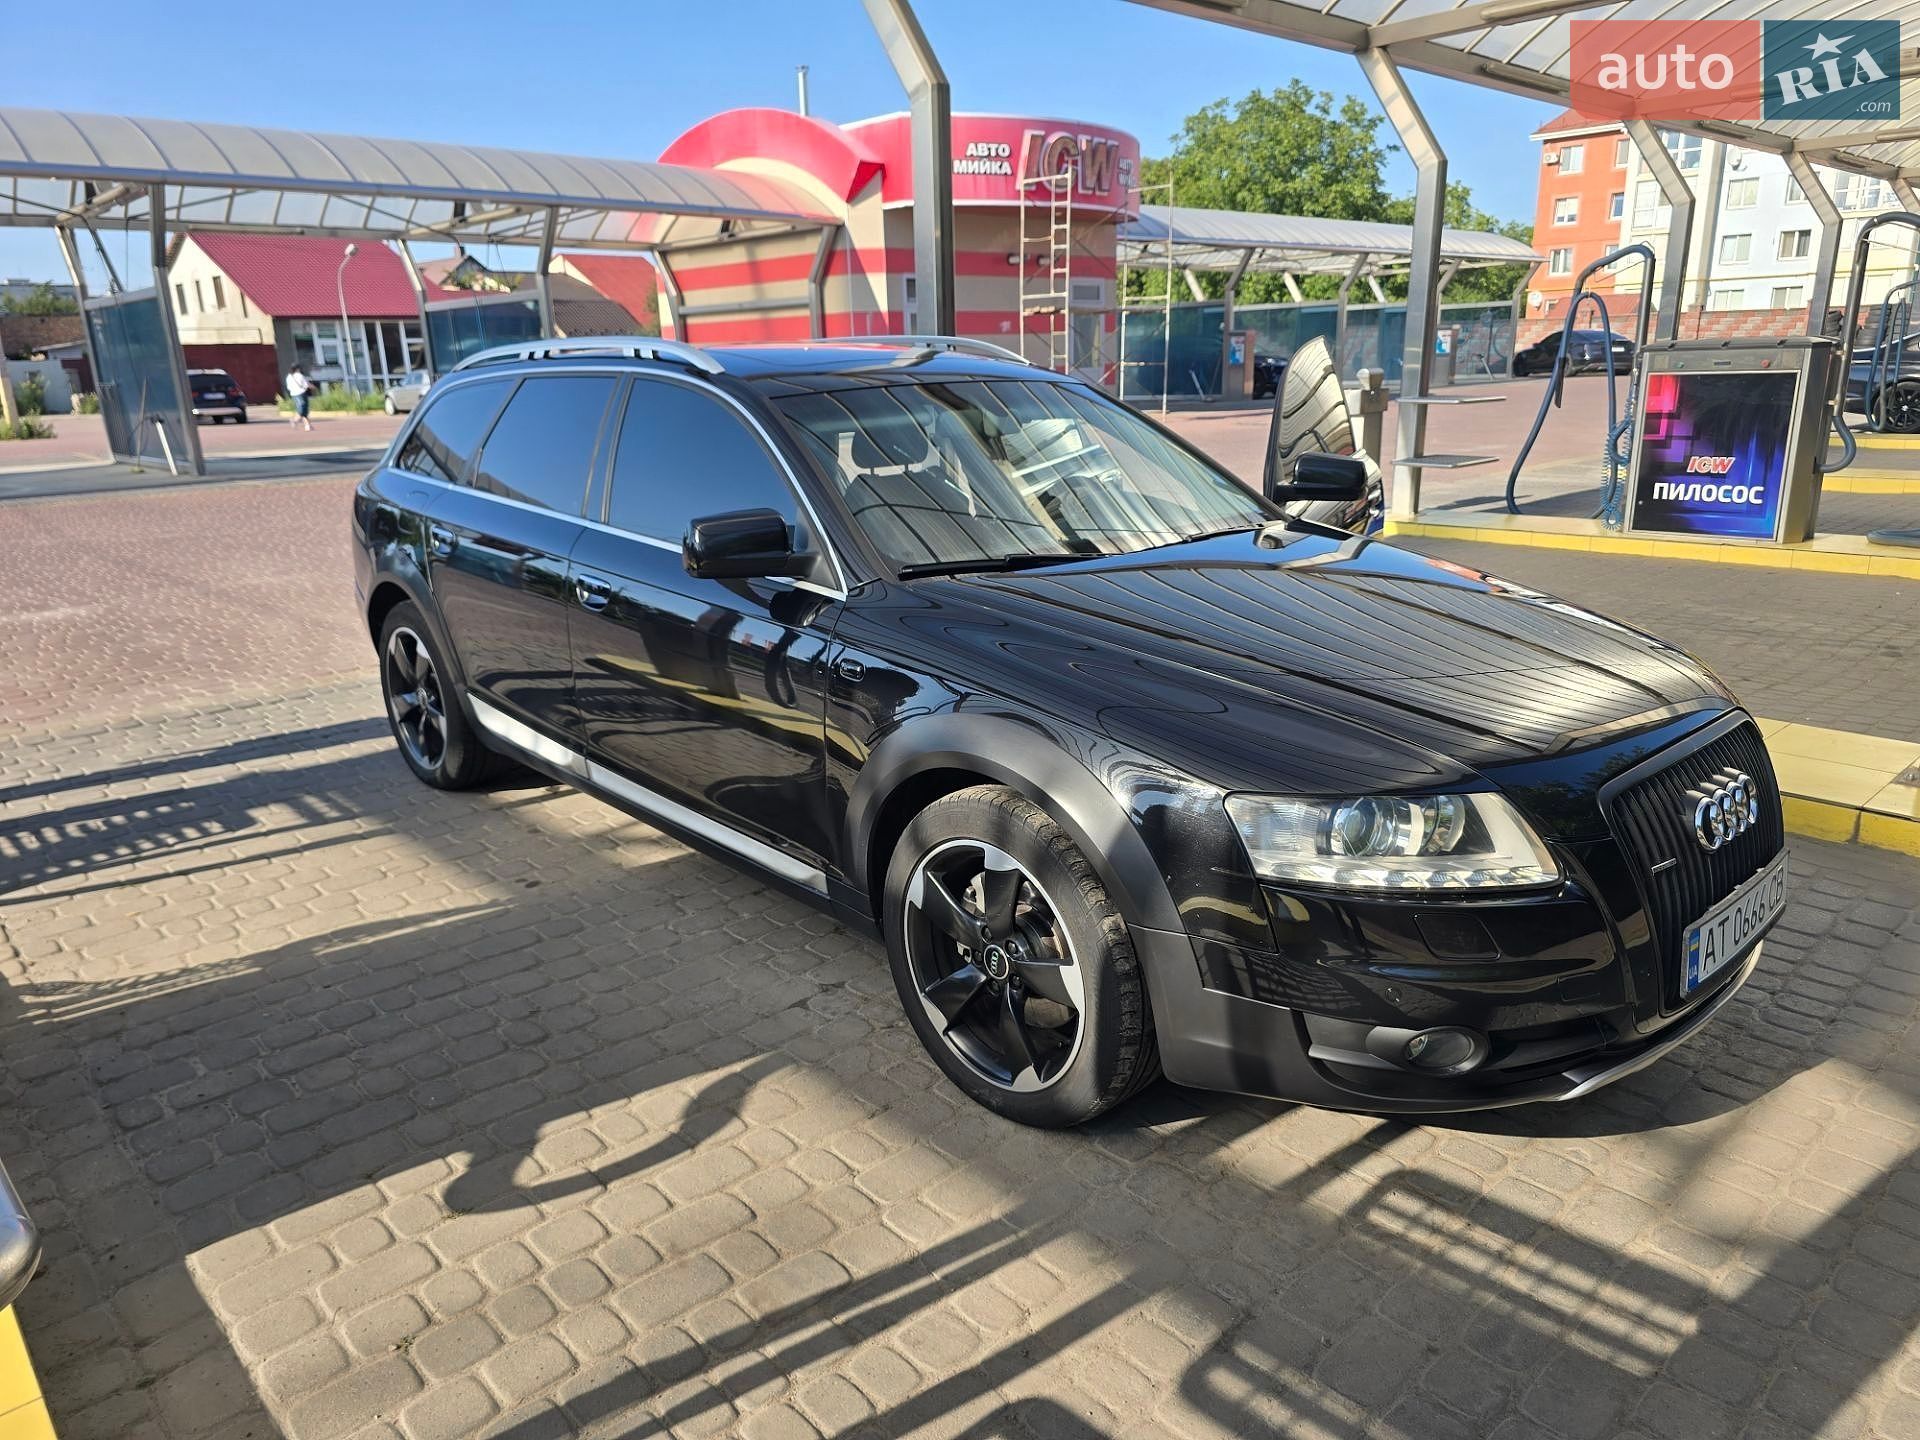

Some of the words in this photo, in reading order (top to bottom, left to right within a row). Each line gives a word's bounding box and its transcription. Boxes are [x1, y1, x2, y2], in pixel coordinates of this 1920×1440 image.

[965, 141, 1011, 158] АВТО
[952, 158, 1012, 176] МИЙКА
[1016, 129, 1119, 196] ICW
[1687, 455, 1735, 474] ICW
[1652, 481, 1765, 505] ПИЛОСОС
[1702, 915, 1730, 972] AT
[1733, 883, 1767, 946] 0666
